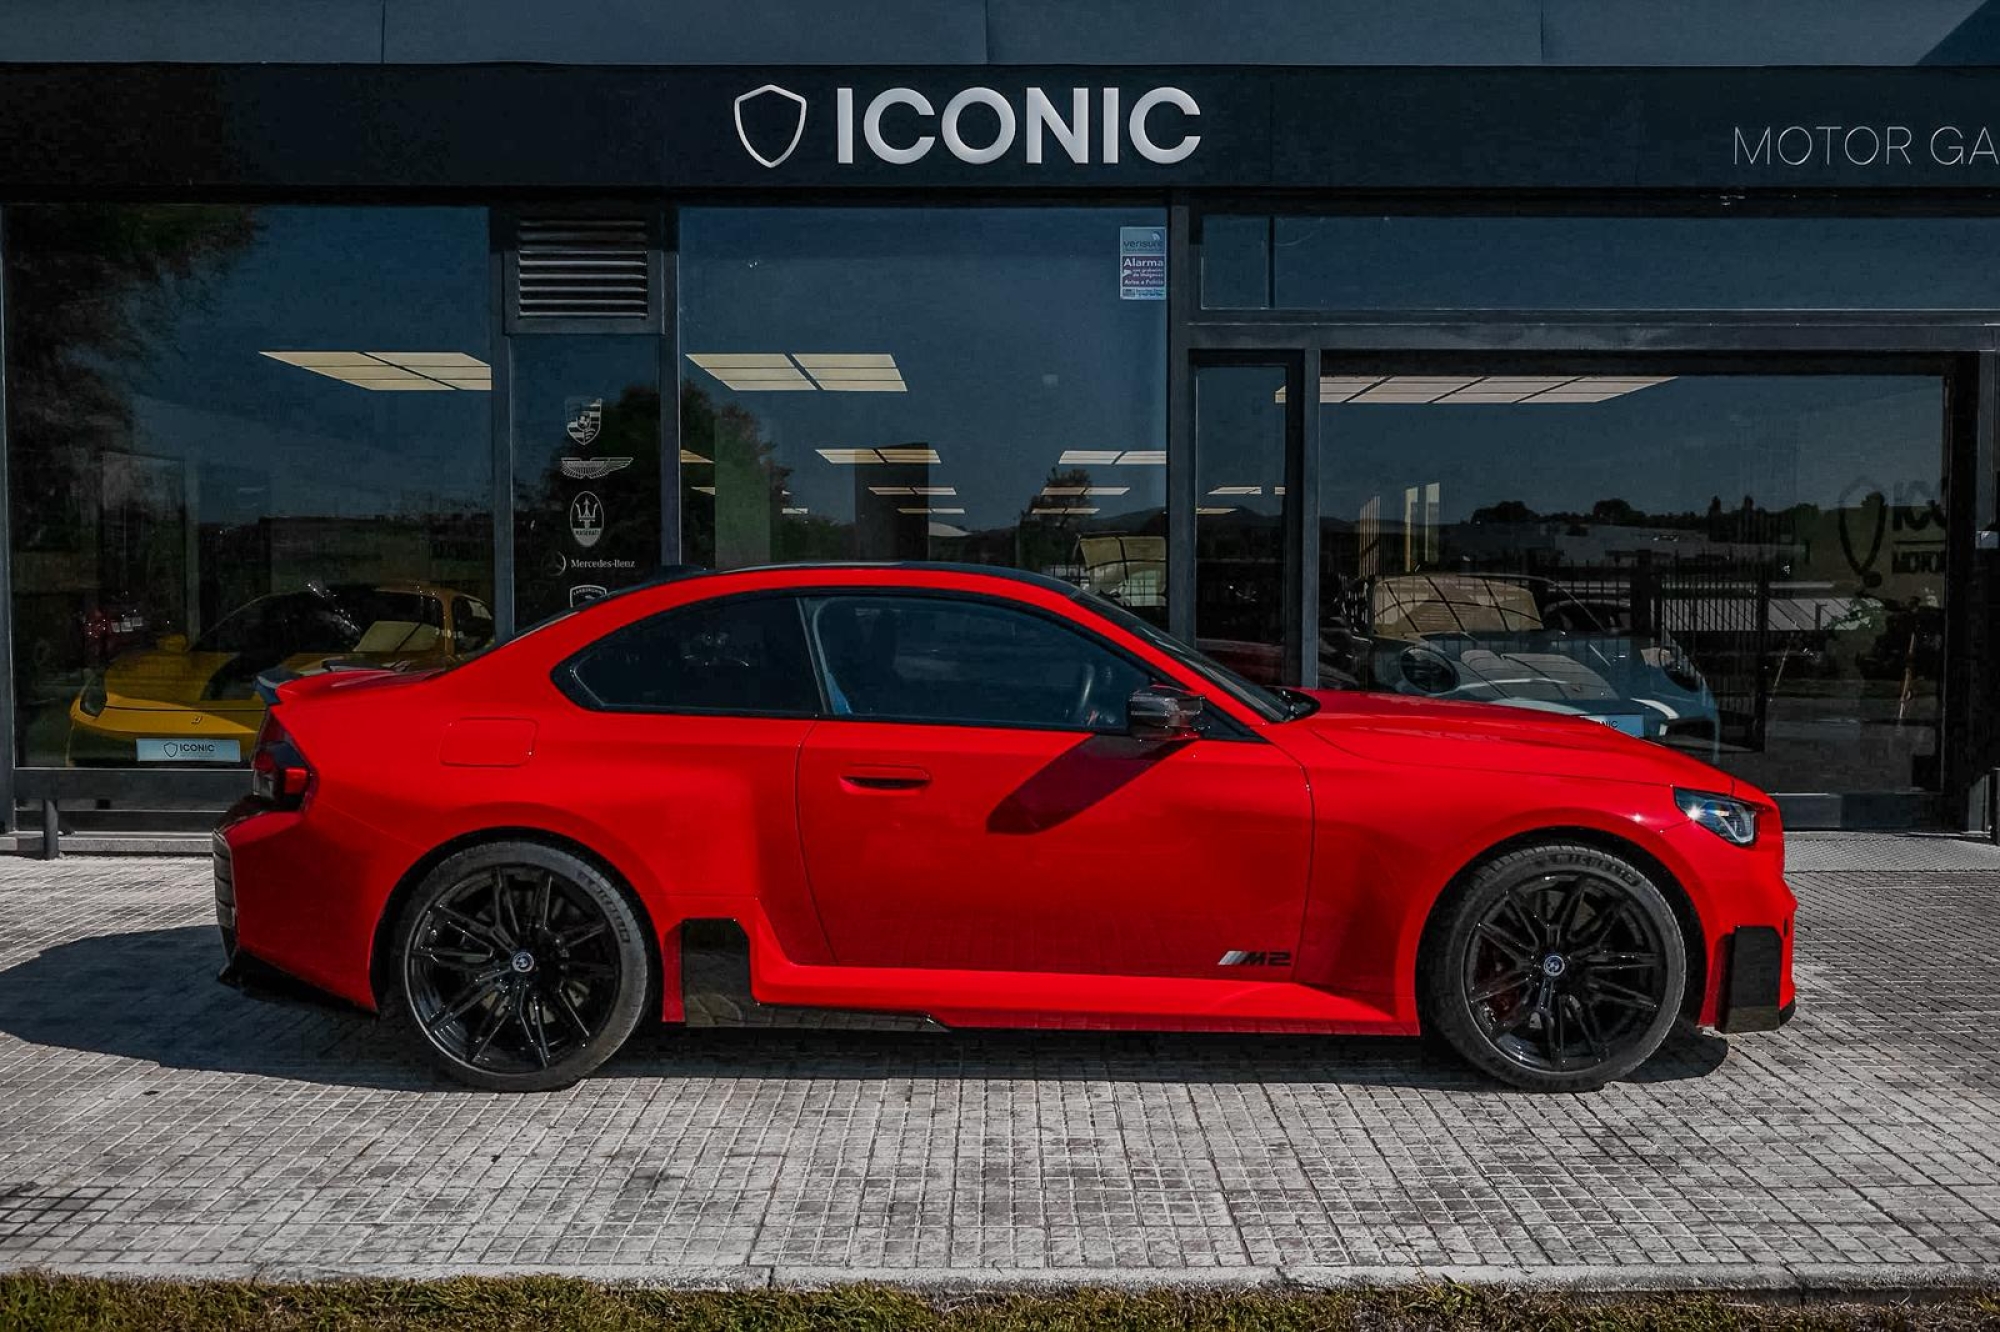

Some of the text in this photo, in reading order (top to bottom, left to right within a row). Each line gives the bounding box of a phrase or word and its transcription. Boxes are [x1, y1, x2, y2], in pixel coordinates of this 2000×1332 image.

[836, 86, 1202, 165] ICONIC
[1734, 125, 2000, 167] MOTOR GA
[1123, 257, 1165, 267] Alarma
[570, 559, 636, 568] Mercedes-Benz
[179, 743, 216, 752] ICONIC
